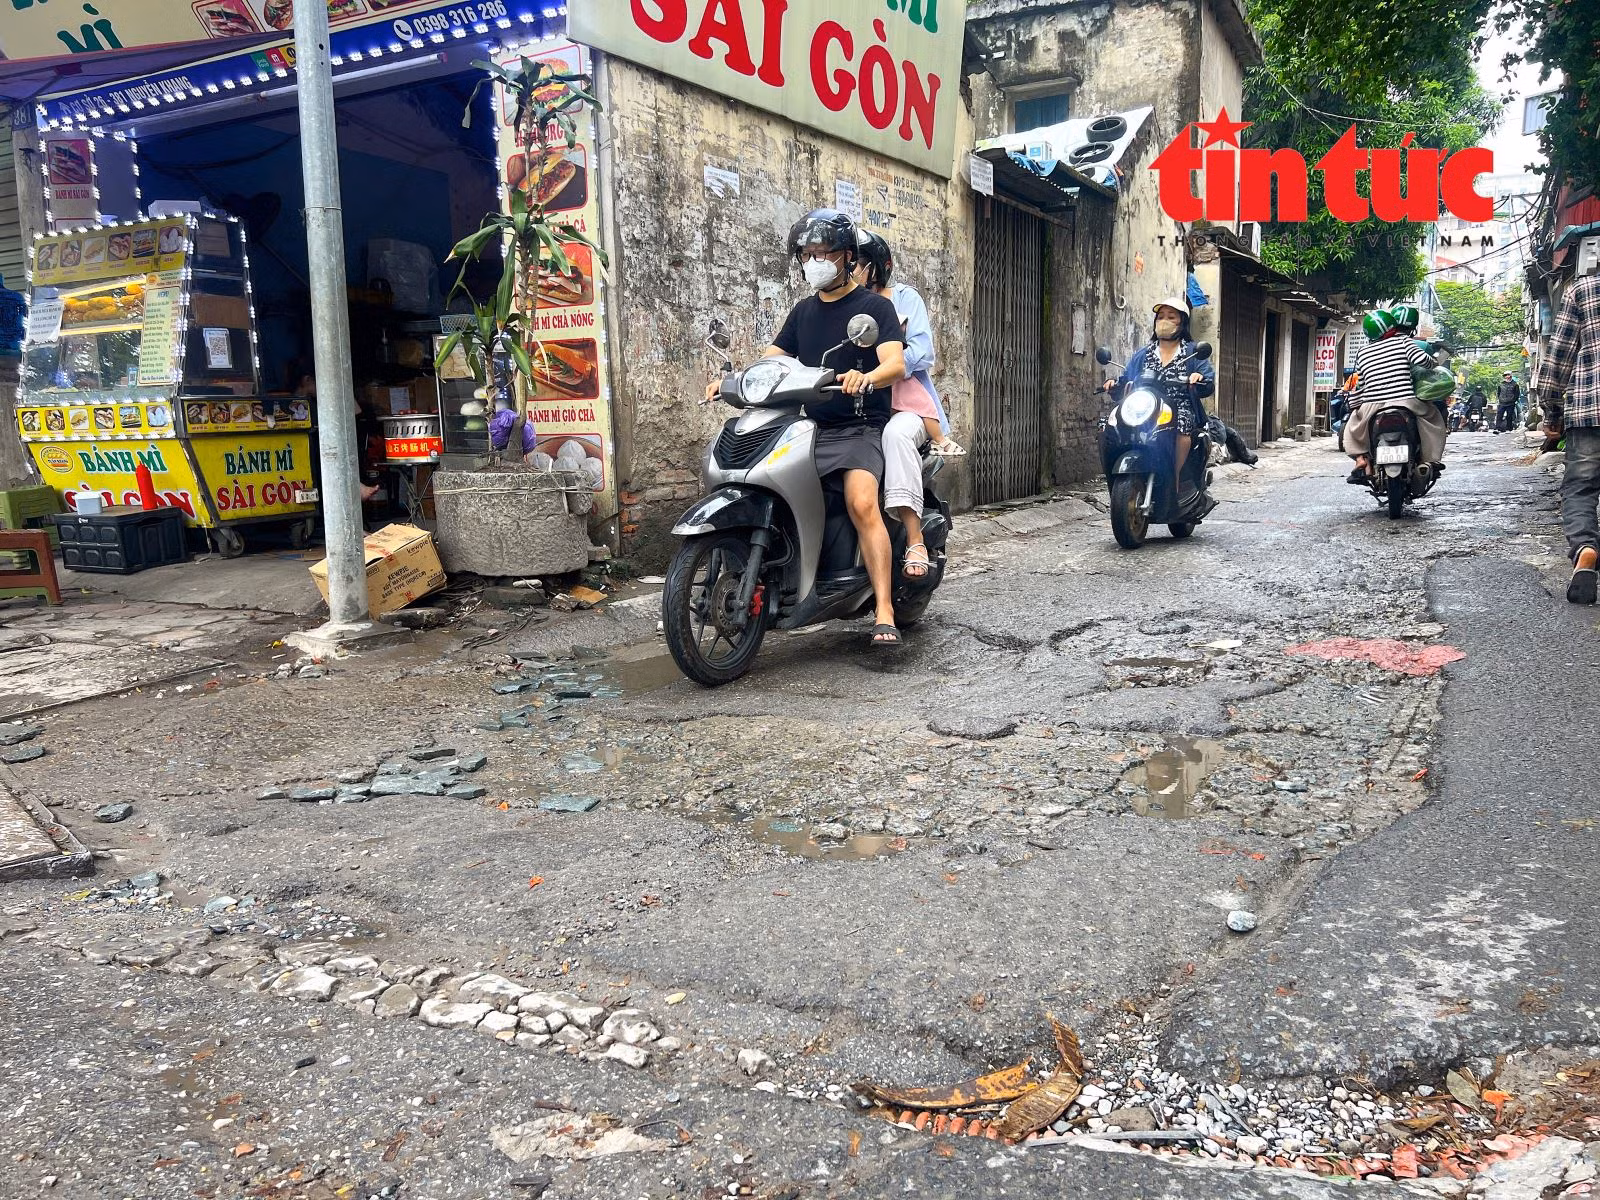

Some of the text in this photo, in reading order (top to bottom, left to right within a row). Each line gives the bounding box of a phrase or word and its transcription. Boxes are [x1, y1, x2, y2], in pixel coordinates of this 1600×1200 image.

[413, 0, 507, 34] 0398 316 286
[109, 91, 128, 105] 381
[158, 76, 194, 94] KHANG
[810, 18, 940, 150] GÒN
[541, 312, 551, 330] MÌ
[552, 309, 569, 329] CHẢ
[570, 309, 594, 328] NÓNG
[1317, 335, 1336, 346] TIVI
[1316, 350, 1335, 360] LCD
[528, 406, 550, 423] BÁNH
[551, 405, 560, 422] MÌ
[578, 403, 595, 422] CHẢ
[386, 442, 430, 453] 山石烤肠机
[78, 445, 133, 473] BÁNH
[137, 444, 168, 472] MÌ
[224, 443, 294, 475] BÁNH MÌ
[217, 479, 256, 511] SÀI
[406, 539, 429, 554] kewpie
[387, 565, 409, 581] KEWPIE
